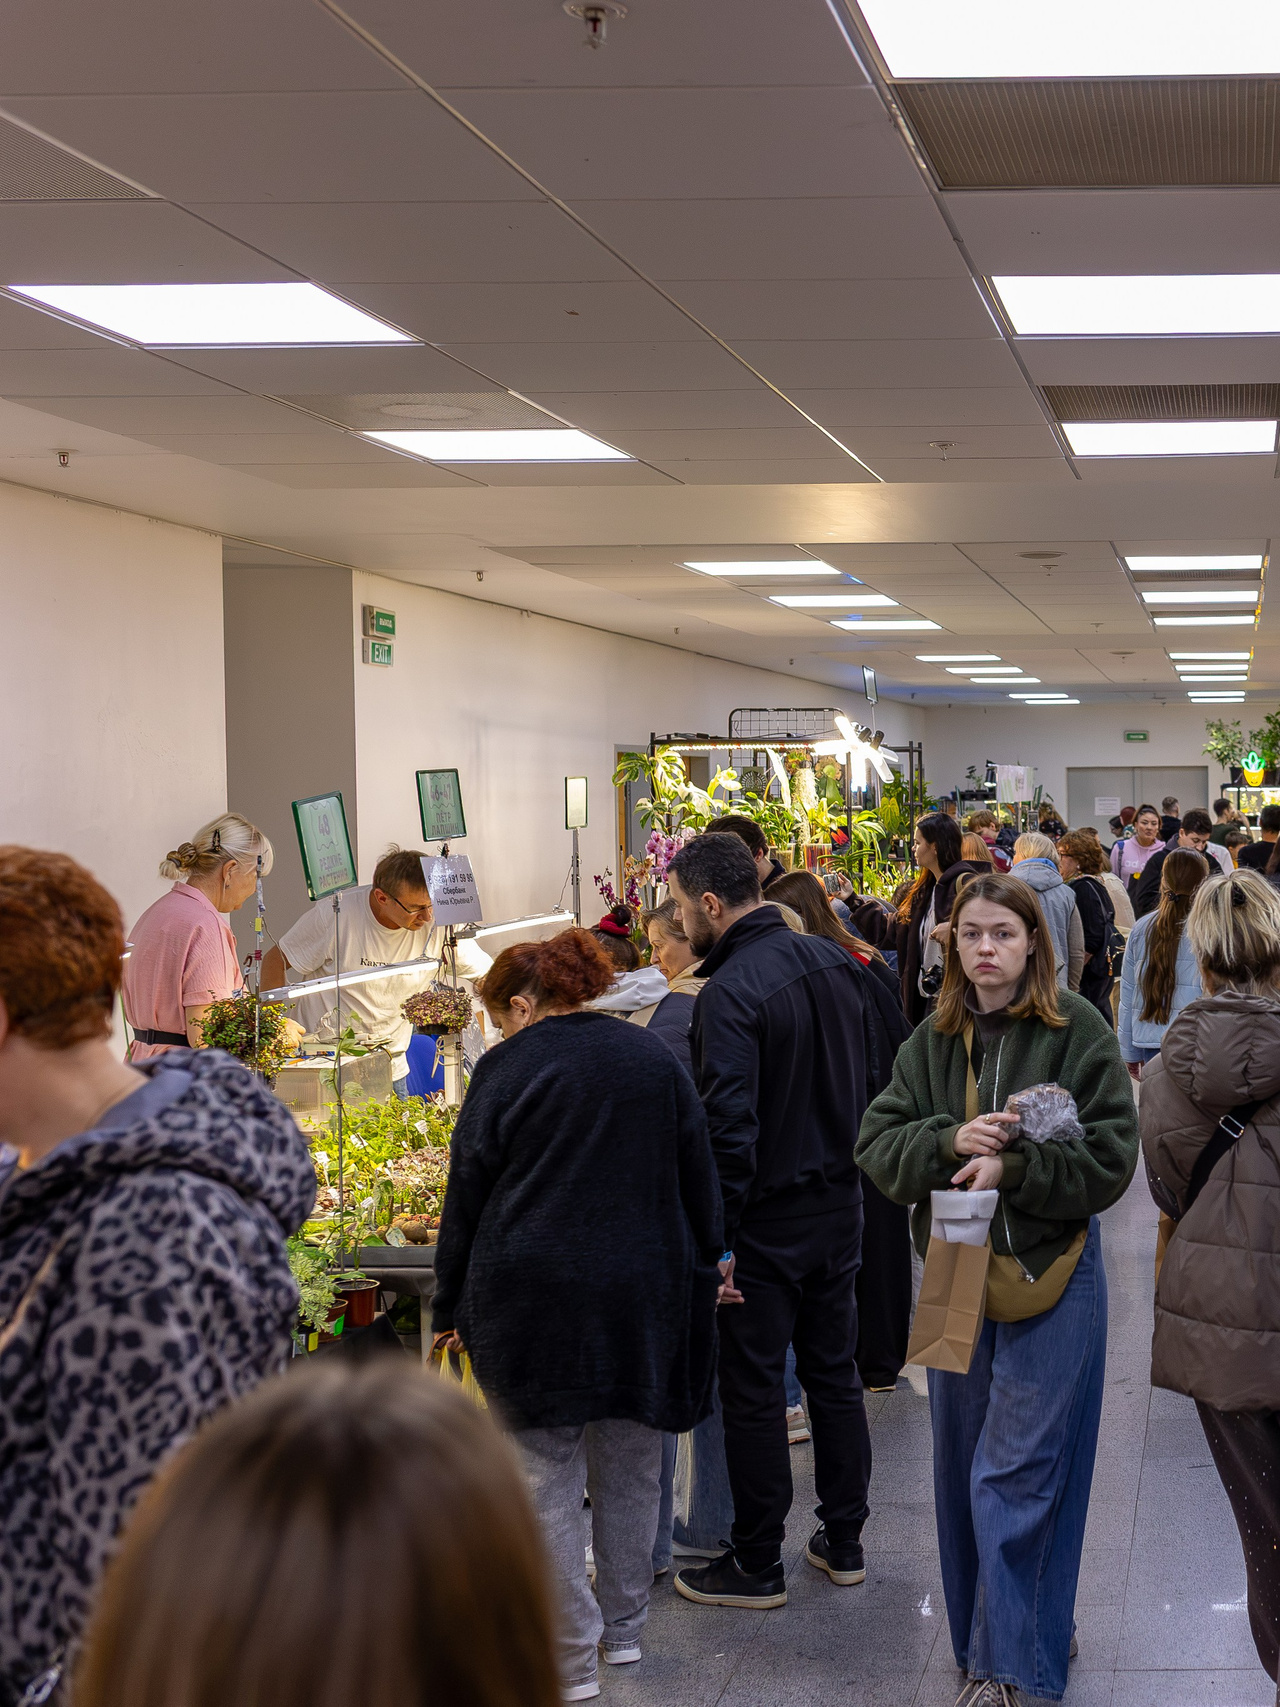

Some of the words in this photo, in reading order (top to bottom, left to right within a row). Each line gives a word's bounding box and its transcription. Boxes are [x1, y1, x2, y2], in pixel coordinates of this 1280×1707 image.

[375, 644, 388, 663] EXIT
[318, 813, 331, 836] 48
[442, 886, 467, 895] Сбербанк
